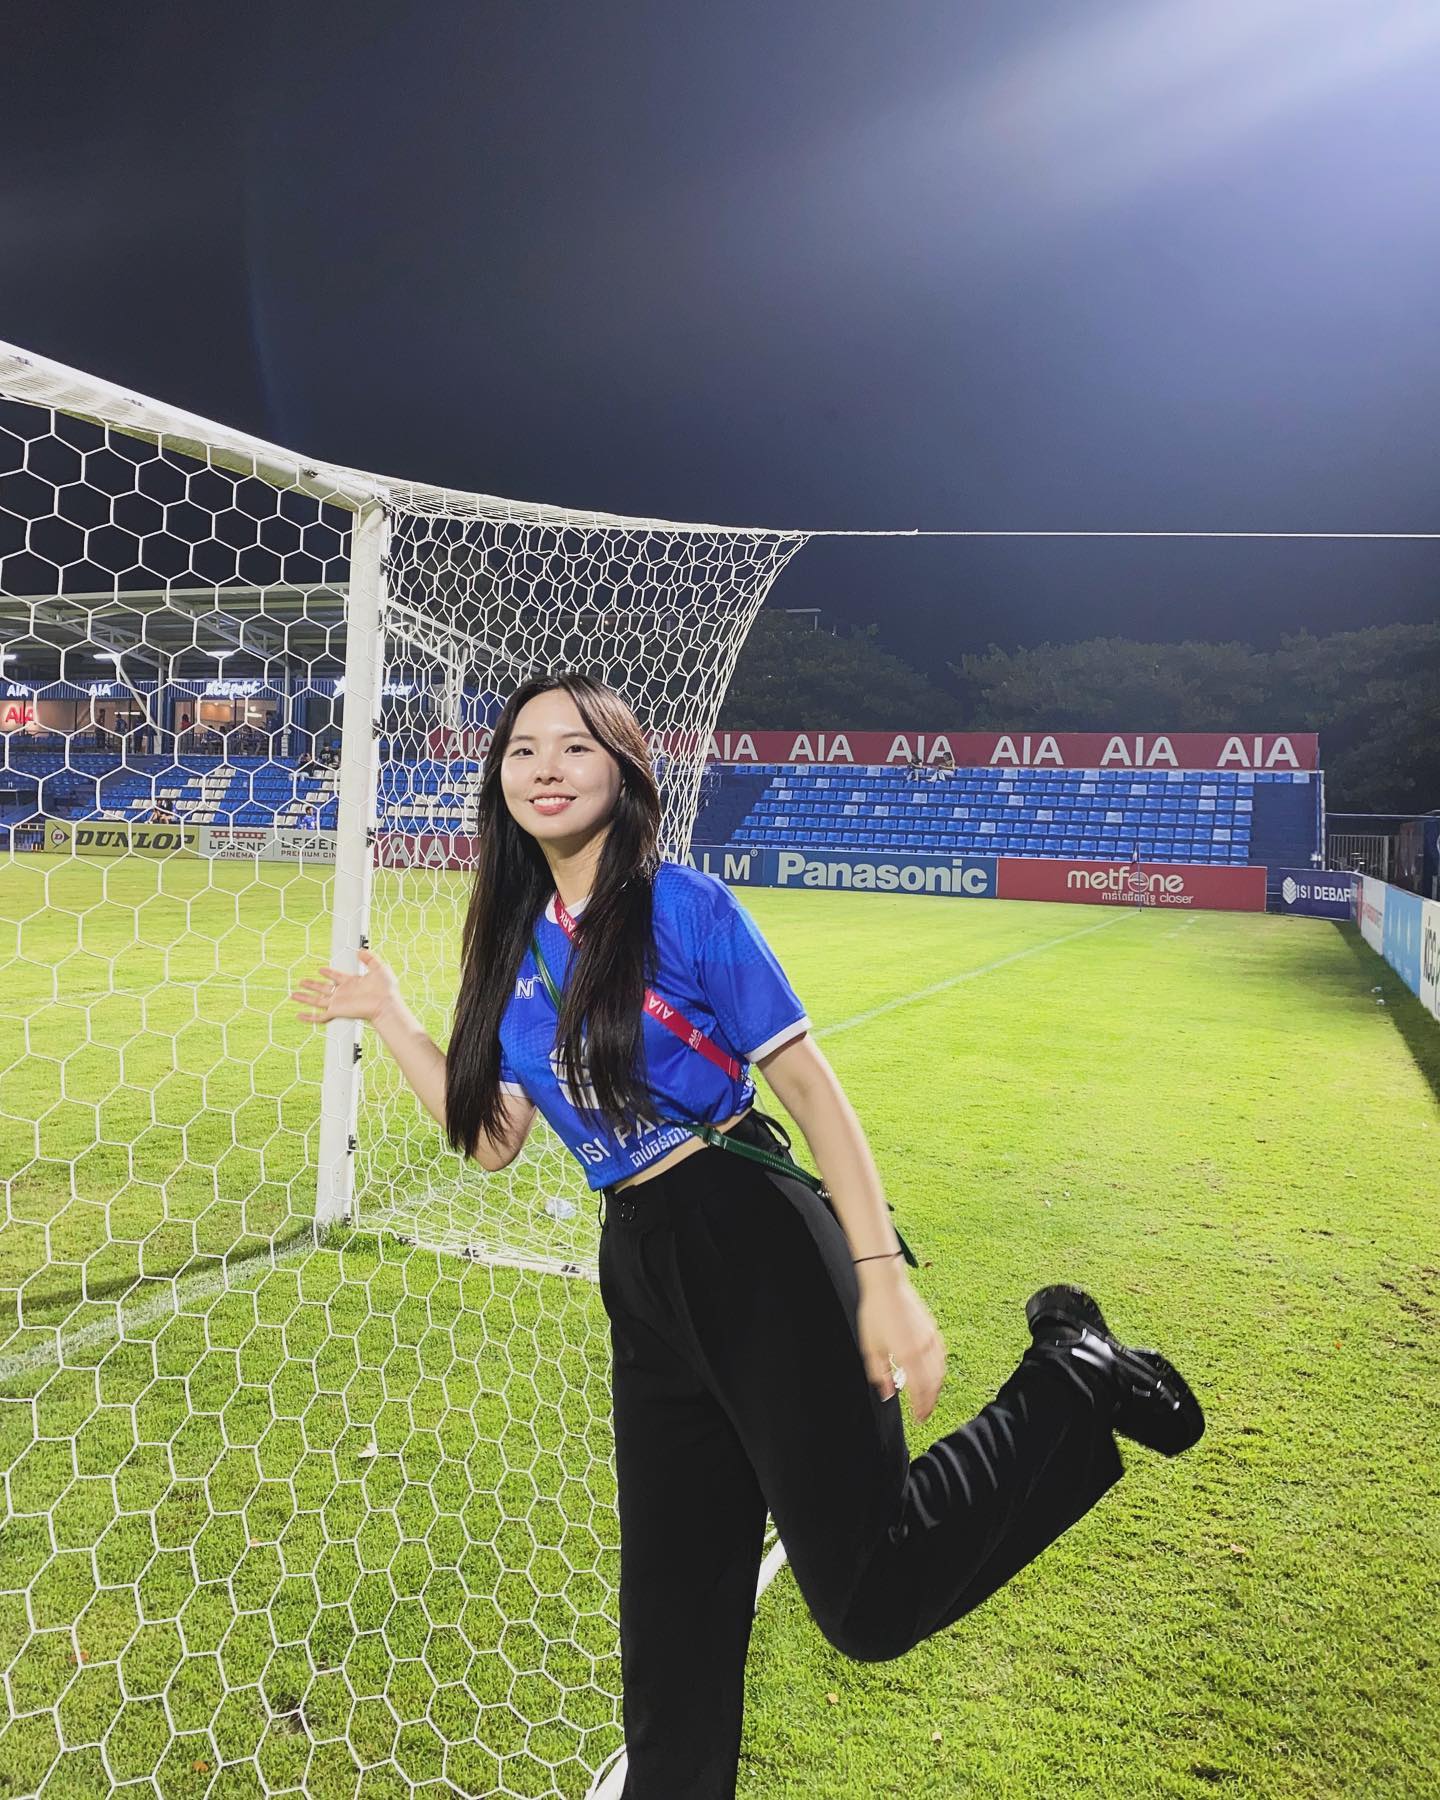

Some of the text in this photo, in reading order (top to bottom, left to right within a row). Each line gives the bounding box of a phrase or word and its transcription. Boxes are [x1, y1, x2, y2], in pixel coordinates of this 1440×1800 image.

[7, 684, 29, 697] AIA
[88, 684, 111, 697] AIA
[5, 706, 36, 725] AIA
[443, 732, 493, 758] AIA
[701, 734, 759, 761] AIA
[788, 734, 854, 762] AIA
[886, 735, 956, 763] AIA
[990, 736, 1064, 765] AIA
[1100, 736, 1179, 767] AIA
[1216, 737, 1300, 768] AIA
[75, 830, 195, 850] DUNLOP
[209, 840, 266, 852] LEGEND
[281, 850, 319, 858] PREMIUM
[777, 852, 988, 894] Panasonic
[1067, 866, 1184, 893] metfone
[1160, 894, 1194, 904] closer
[1296, 885, 1311, 899] ISI
[648, 995, 674, 1019] AIA
[576, 1137, 611, 1165] ISI
